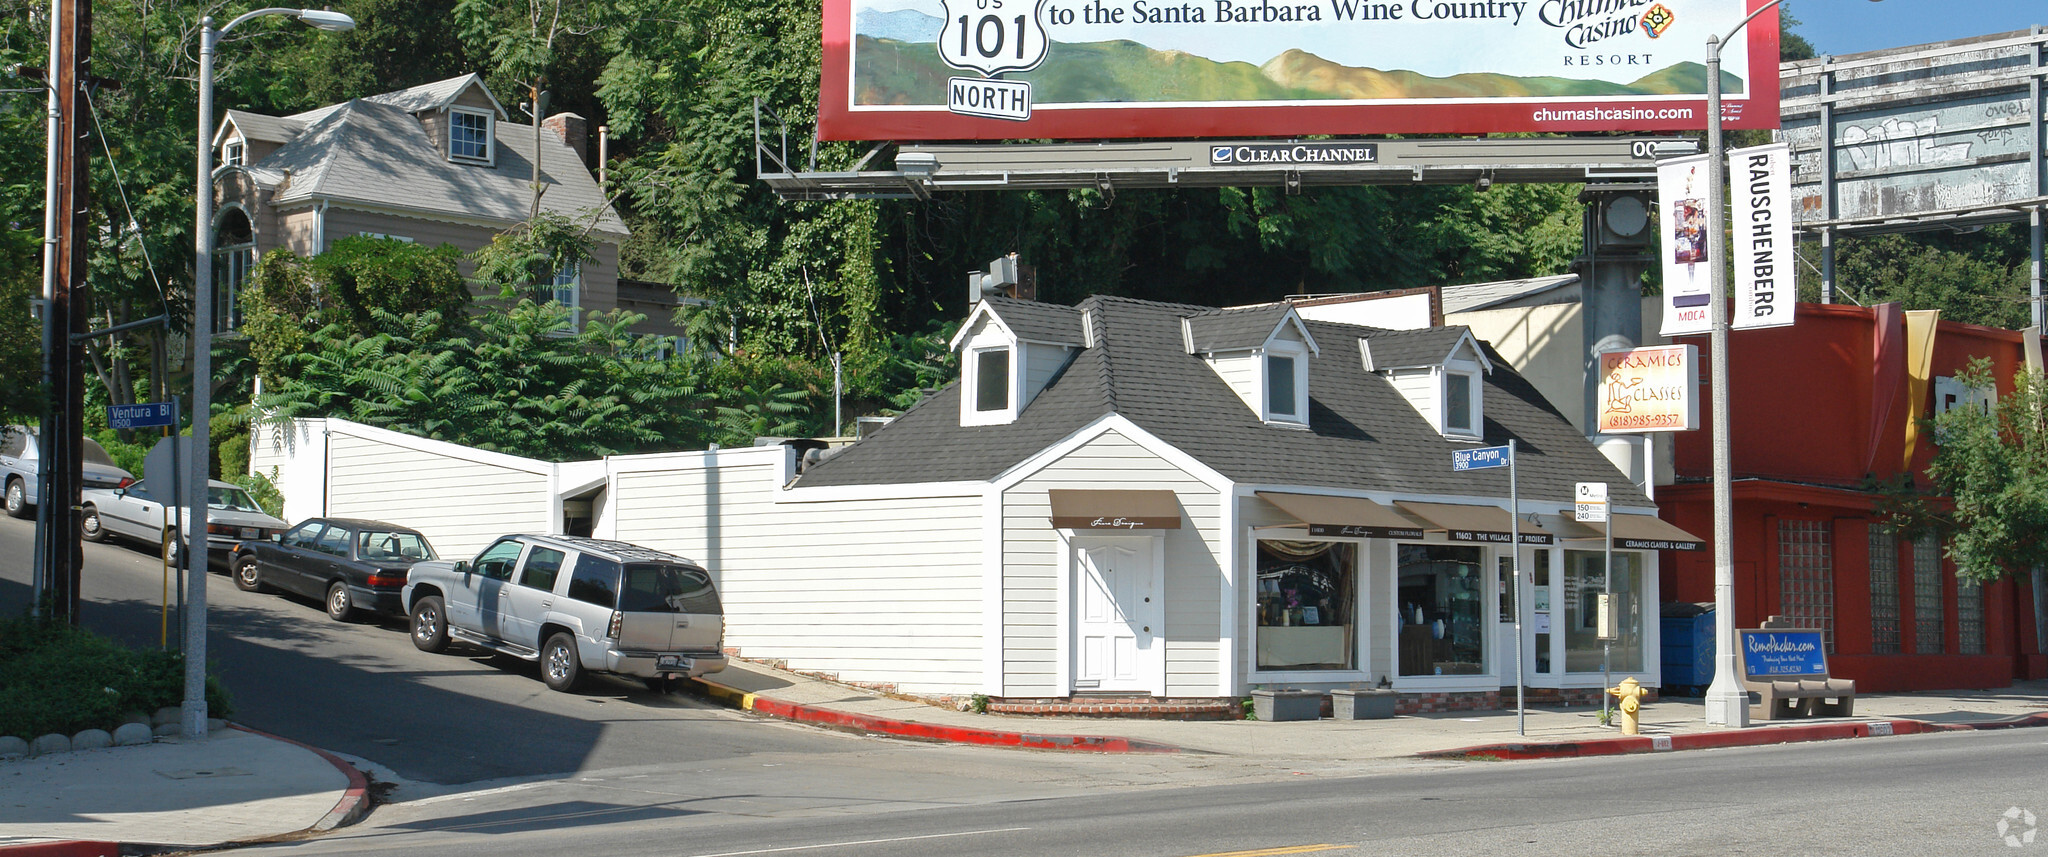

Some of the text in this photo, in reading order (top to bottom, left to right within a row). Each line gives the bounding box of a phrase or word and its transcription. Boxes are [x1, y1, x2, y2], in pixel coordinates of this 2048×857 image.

[1049, 0, 1528, 26] to the Santa Barbara Wine Country
[958, 14, 1026, 60] 101
[1564, 12, 1641, 49] Casino
[1563, 54, 1653, 66] RESORT
[953, 84, 1026, 112] NORTH
[1533, 106, 1693, 122] chumashcasino.com
[1749, 154, 1775, 318] RAUSCHENBERG
[1678, 309, 1706, 322] MOCA
[1607, 353, 1682, 370] CERAMICS
[1633, 386, 1682, 402] CLASSES
[112, 404, 170, 419] Ventura Bl
[112, 419, 131, 428] 11500
[1609, 413, 1679, 427] (818)985-9357
[1454, 449, 1500, 463] Blue Canyon
[1500, 457, 1508, 465] Dr
[1455, 461, 1469, 470] 3900
[1577, 504, 1590, 512] 150
[1577, 512, 1590, 520] 240
[1455, 531, 1472, 540] 11602
[1476, 533, 1487, 541] THE
[1489, 534, 1511, 542] VILLAGE
[1525, 535, 1547, 543] PROJECT
[1625, 540, 1650, 548] CERAMICS
[1650, 541, 1669, 549] CLASSES
[1675, 542, 1697, 550] GALLERY
[1748, 634, 1816, 654] RemoPacker.com
